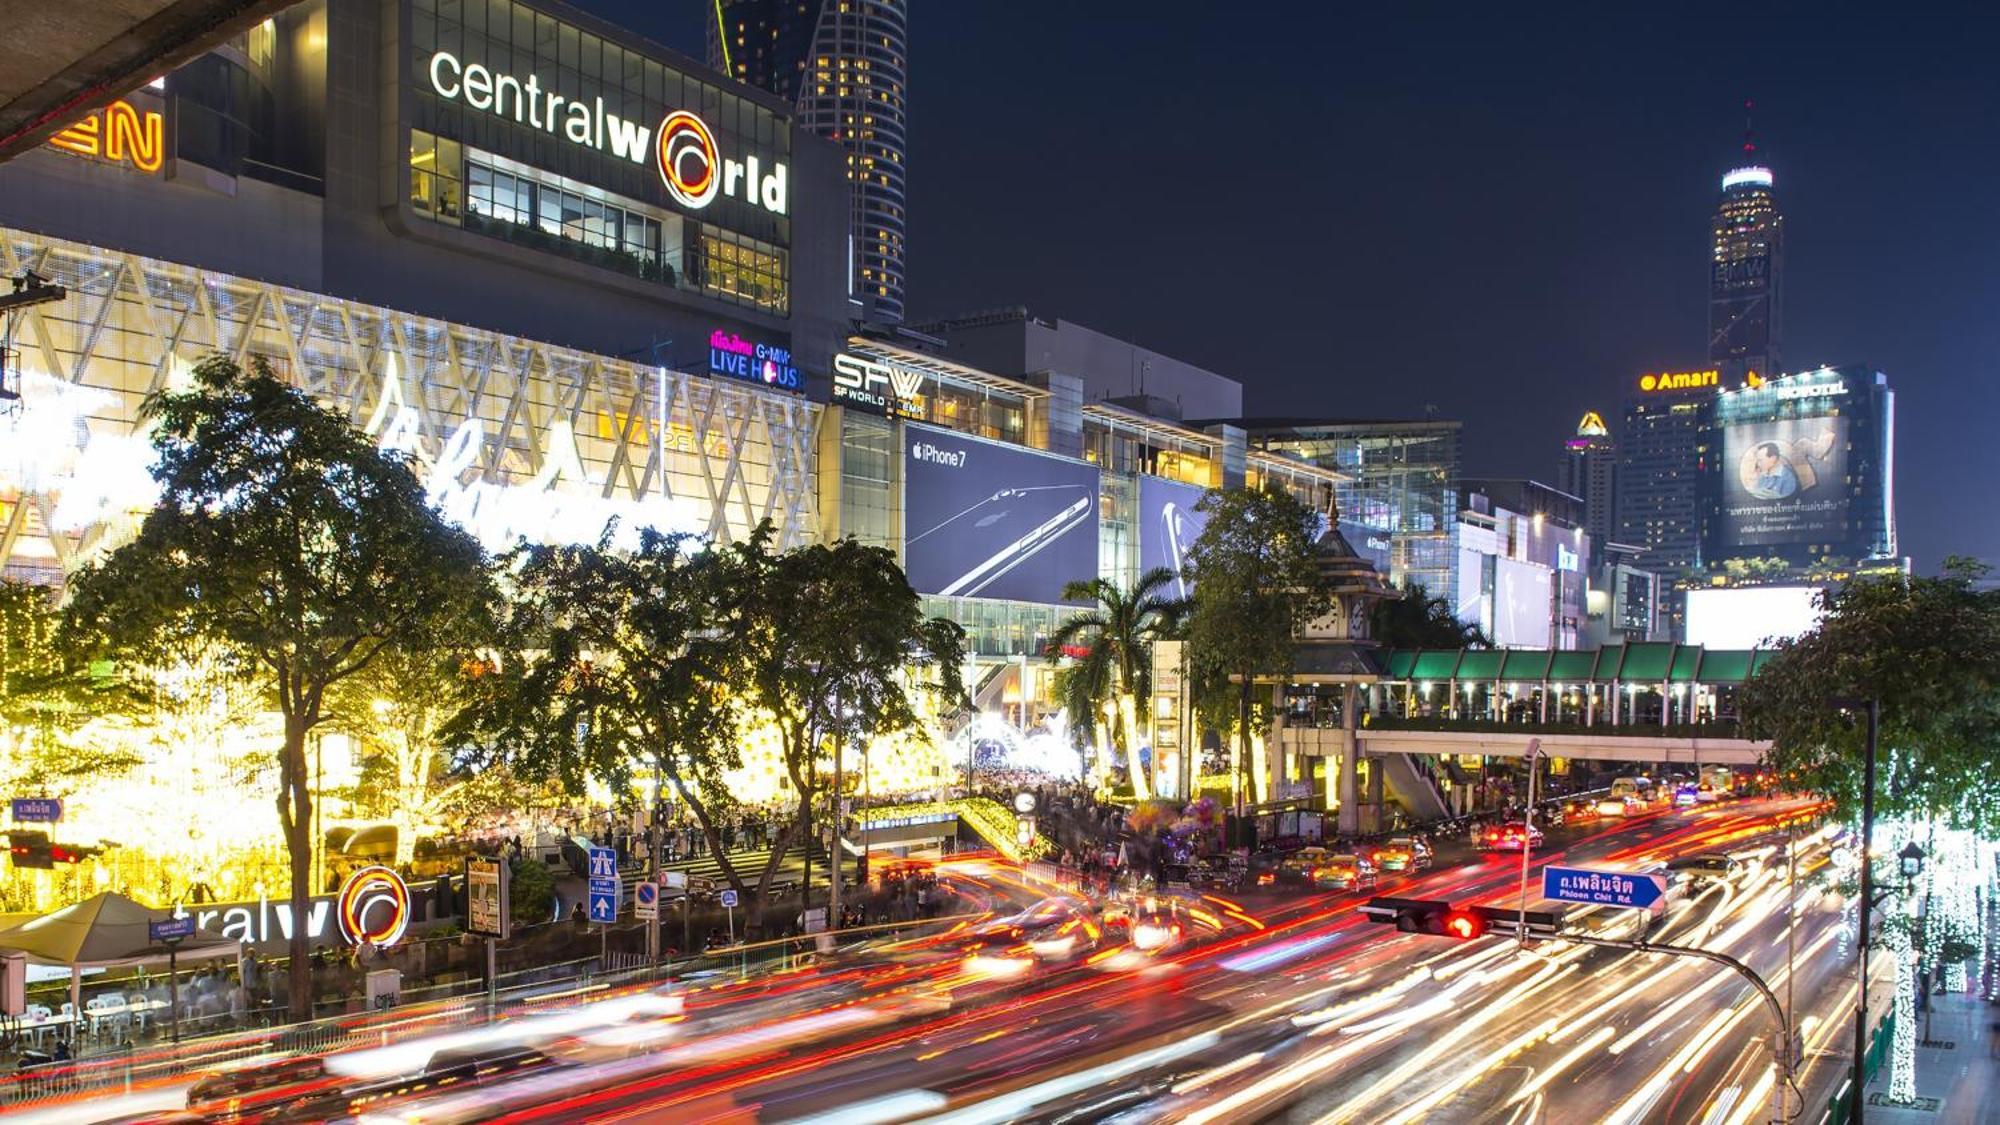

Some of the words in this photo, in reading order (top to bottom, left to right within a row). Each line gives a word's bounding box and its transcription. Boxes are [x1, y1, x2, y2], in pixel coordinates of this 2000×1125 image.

[711, 348, 747, 376] LIVE
[848, 389, 885, 406] WORLD
[922, 443, 958, 467] iPhone
[958, 450, 966, 468] 7
